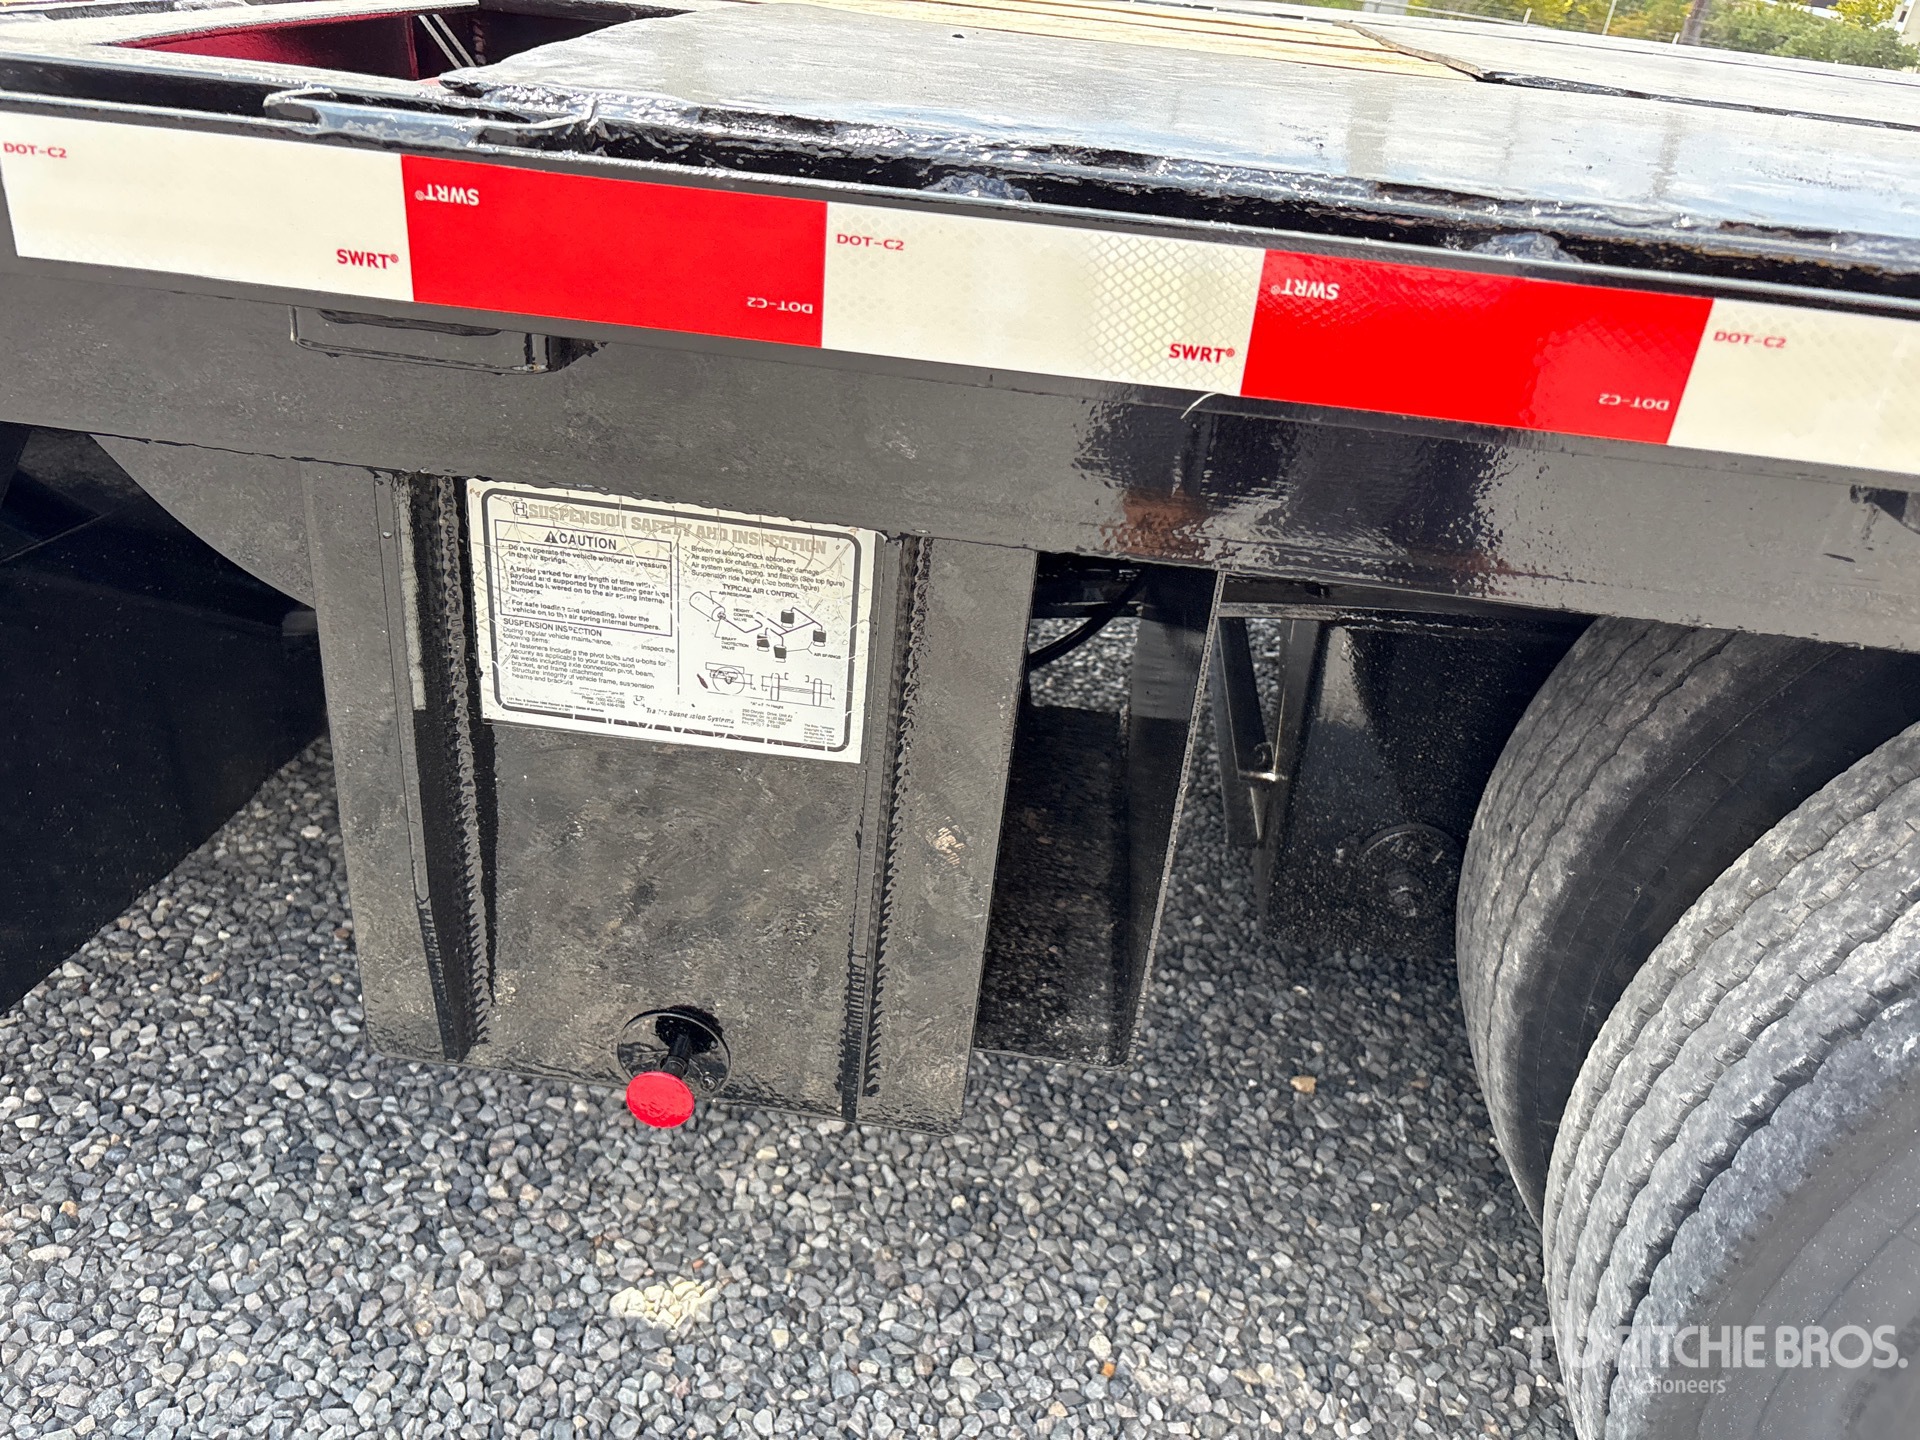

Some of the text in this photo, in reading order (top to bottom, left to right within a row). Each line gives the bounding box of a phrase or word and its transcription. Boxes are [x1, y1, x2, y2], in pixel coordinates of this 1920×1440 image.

[3, 142, 68, 159] DOT-C2
[836, 233, 905, 251] DOT-C2
[746, 296, 813, 314] DOT-C2
[1713, 331, 1787, 349] DOT-C2
[1598, 393, 1670, 411] DOT-C2
[528, 504, 827, 554] SUSPENSION SAFETY AND INSPECTION
[559, 533, 617, 551] CAUTION
[533, 548, 559, 556] operate
[560, 550, 571, 558] the
[572, 552, 597, 561] vehicle
[598, 556, 624, 564] without
[636, 561, 667, 570] pressure
[691, 545, 713, 553] Broken
[765, 555, 796, 564] absorbers
[701, 555, 724, 564] springs
[795, 568, 820, 577] damage
[510, 573, 537, 581] payload
[553, 578, 587, 587] supported
[516, 566, 536, 574] trailer
[588, 575, 610, 584] length
[619, 579, 635, 587] time
[691, 569, 727, 580] Suspension
[741, 576, 761, 585] height
[777, 580, 800, 589] bottom
[800, 583, 820, 593] figure)
[701, 563, 723, 571] system
[779, 573, 799, 582] fittings
[826, 579, 845, 588] figure)
[510, 579, 534, 587] should
[592, 589, 604, 597] the
[722, 583, 751, 593] TYPICAL
[766, 589, 800, 599] CONTROL
[512, 606, 536, 615] vehicle
[579, 615, 601, 624] spring
[602, 618, 628, 626] internal
[629, 621, 661, 631] bumpers.
[618, 613, 637, 621] lower
[502, 626, 523, 635] During
[548, 632, 570, 641] vehicle
[503, 618, 602, 637] SUSPENSION INSPECTION
[502, 633, 530, 643] following
[510, 648, 535, 656] security
[545, 652, 576, 661] applicable
[519, 643, 548, 652] fasteners
[635, 657, 657, 666] u-bolts
[657, 659, 667, 667] for
[539, 659, 567, 668] including
[582, 663, 616, 673] connection
[550, 665, 568, 673] frame
[575, 675, 598, 683] vehicle
[619, 680, 655, 690] suspension
[707, 714, 735, 725] Systems
